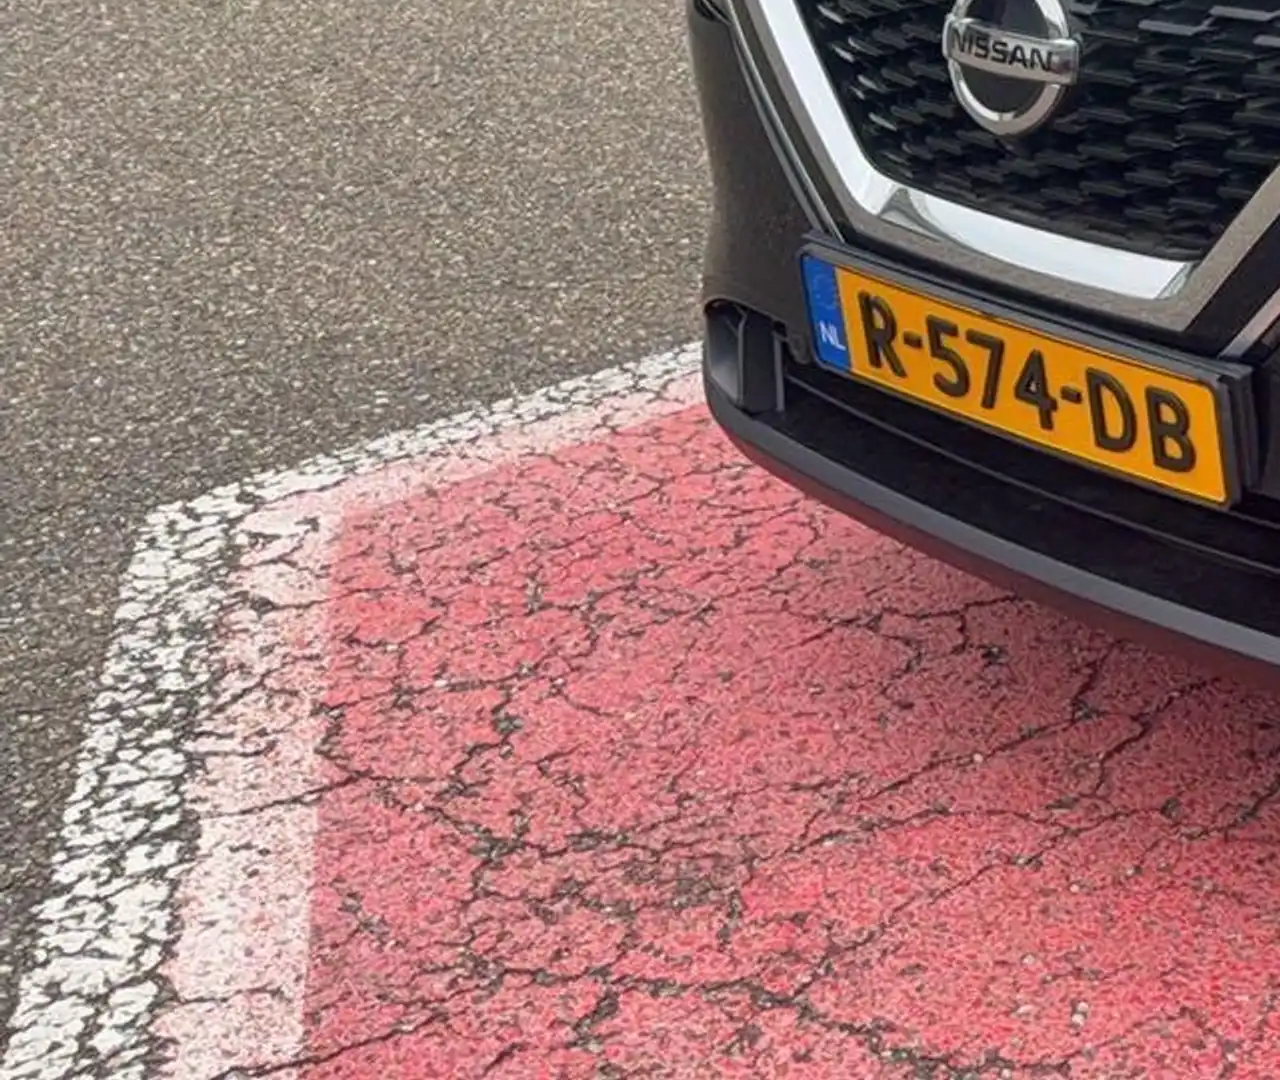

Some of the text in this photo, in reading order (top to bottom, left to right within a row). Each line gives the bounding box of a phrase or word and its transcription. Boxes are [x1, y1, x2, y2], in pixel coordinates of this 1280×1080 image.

[951, 24, 1053, 72] NISSAN
[819, 320, 847, 351] NL
[857, 290, 1197, 473] R-574-DB
